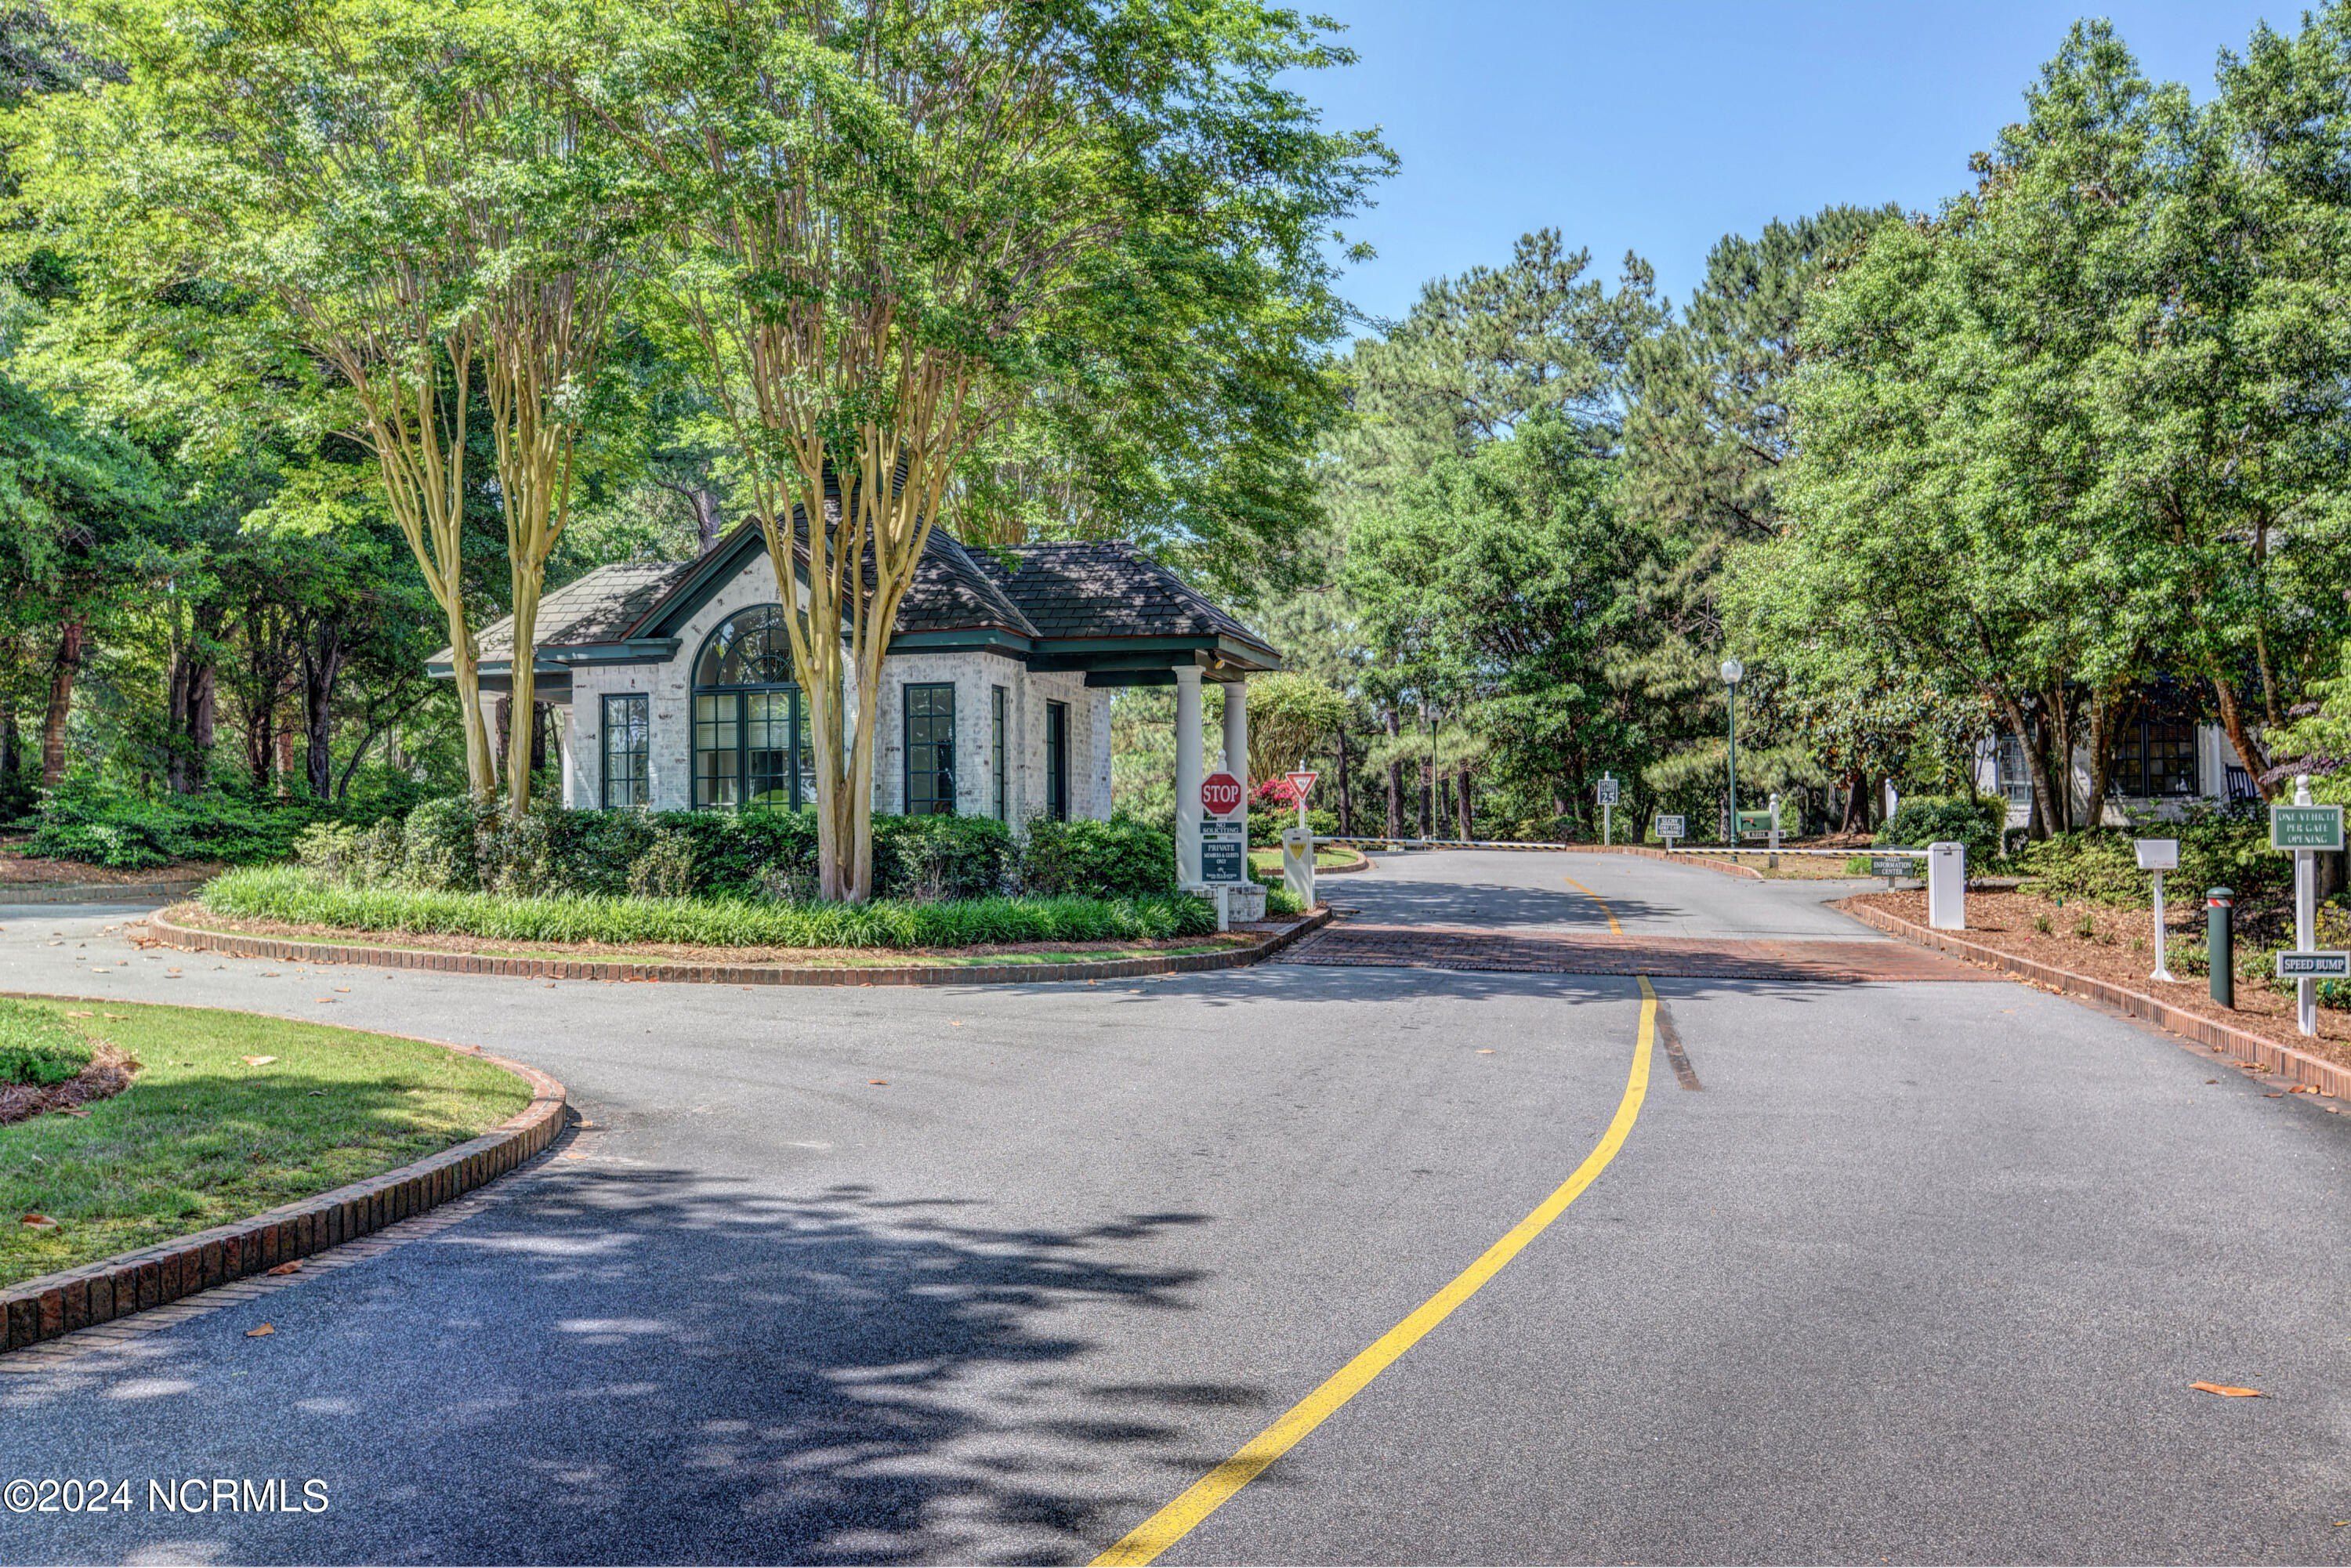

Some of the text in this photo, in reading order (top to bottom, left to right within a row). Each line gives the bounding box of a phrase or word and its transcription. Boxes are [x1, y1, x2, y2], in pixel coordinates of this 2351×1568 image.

[1203, 784, 1239, 803] STOP
[1601, 792, 1615, 803] 25
[2278, 813, 2335, 821] ONE VEHICLE
[2287, 824, 2328, 832] PER GATE
[2288, 835, 2327, 843] OPENING
[2284, 958, 2344, 970] SPEED BUMP
